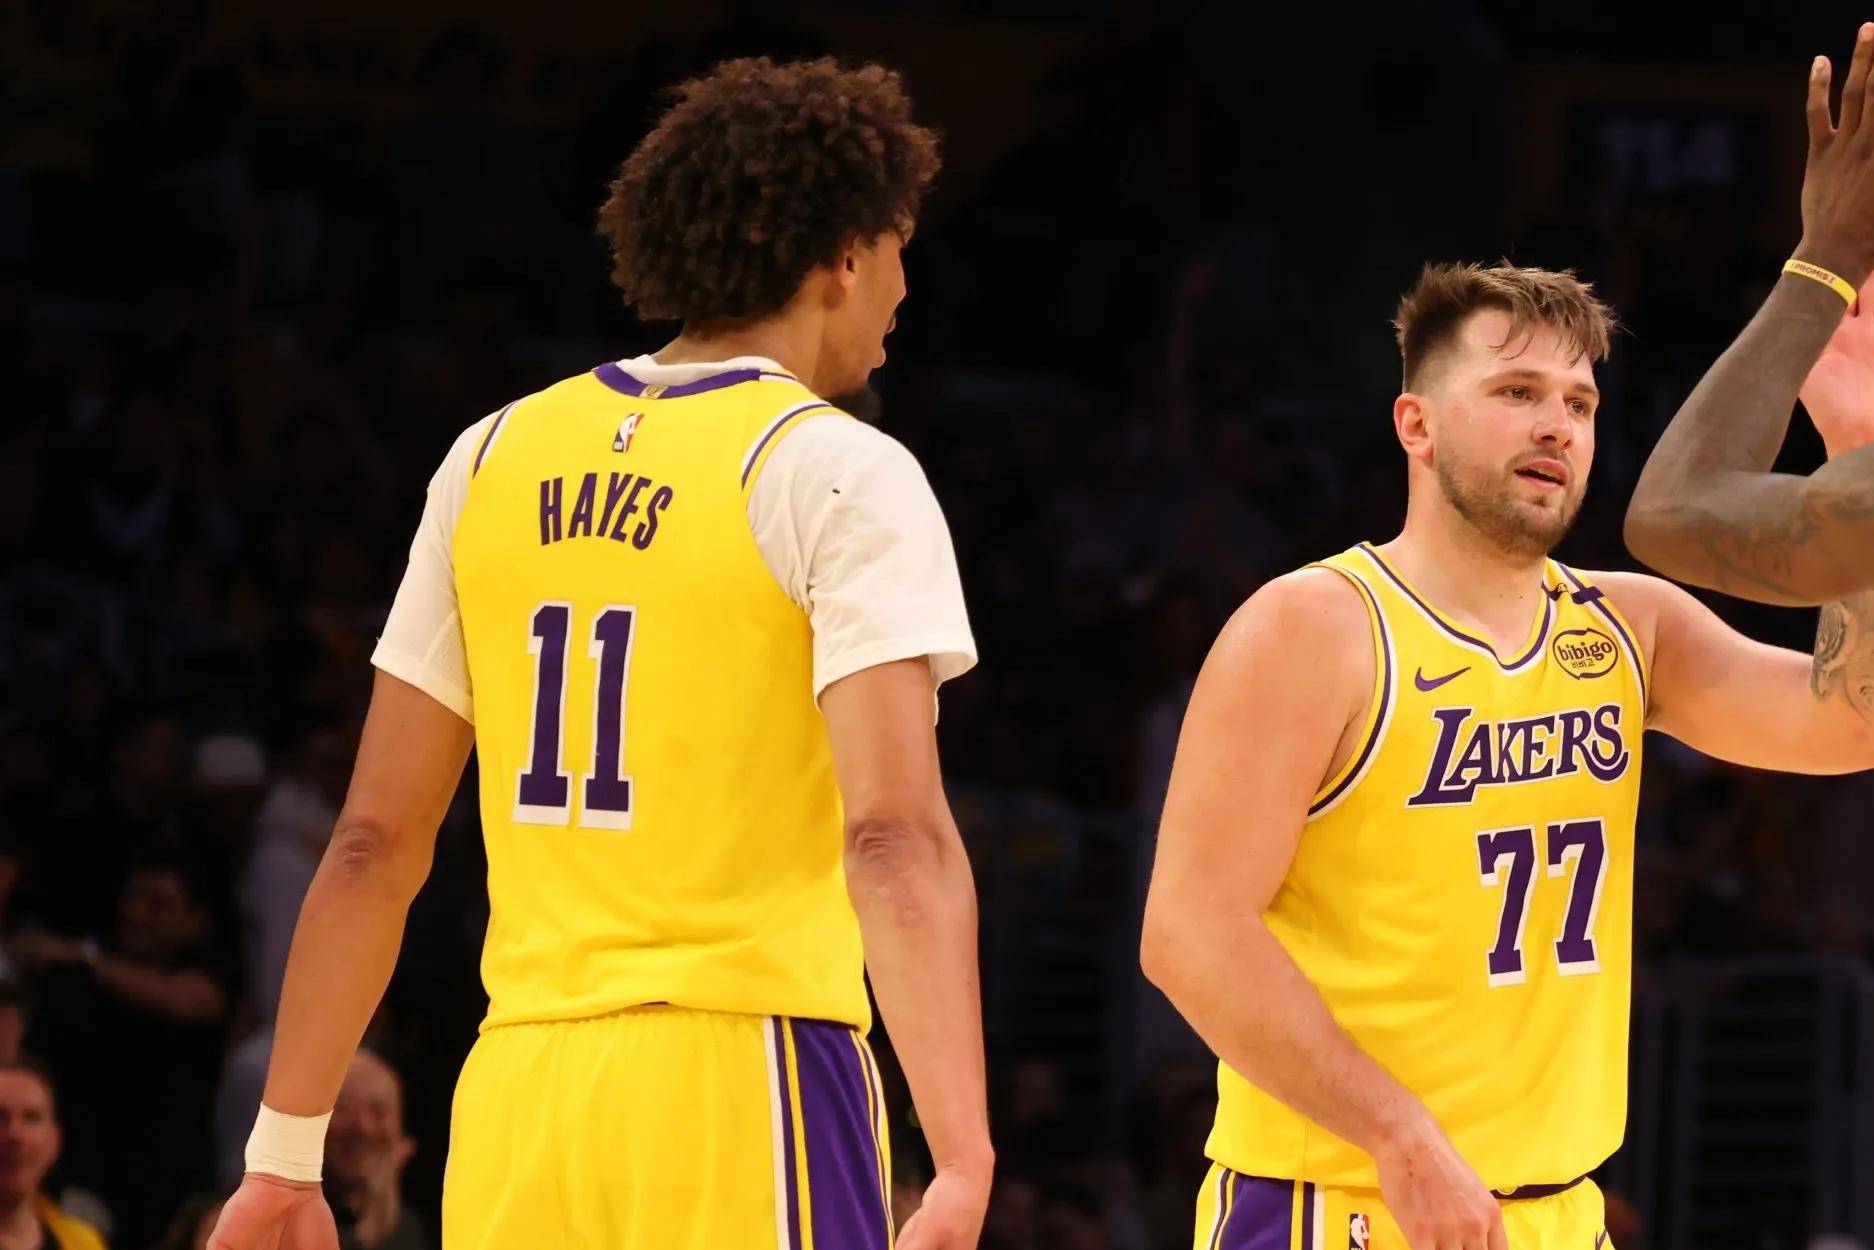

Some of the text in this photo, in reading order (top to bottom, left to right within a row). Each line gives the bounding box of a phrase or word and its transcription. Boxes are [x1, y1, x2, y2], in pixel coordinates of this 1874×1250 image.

[540, 471, 674, 551] HAYES
[1557, 640, 1613, 662] bibigo
[512, 600, 639, 830] 11
[1476, 816, 1609, 988] 77
